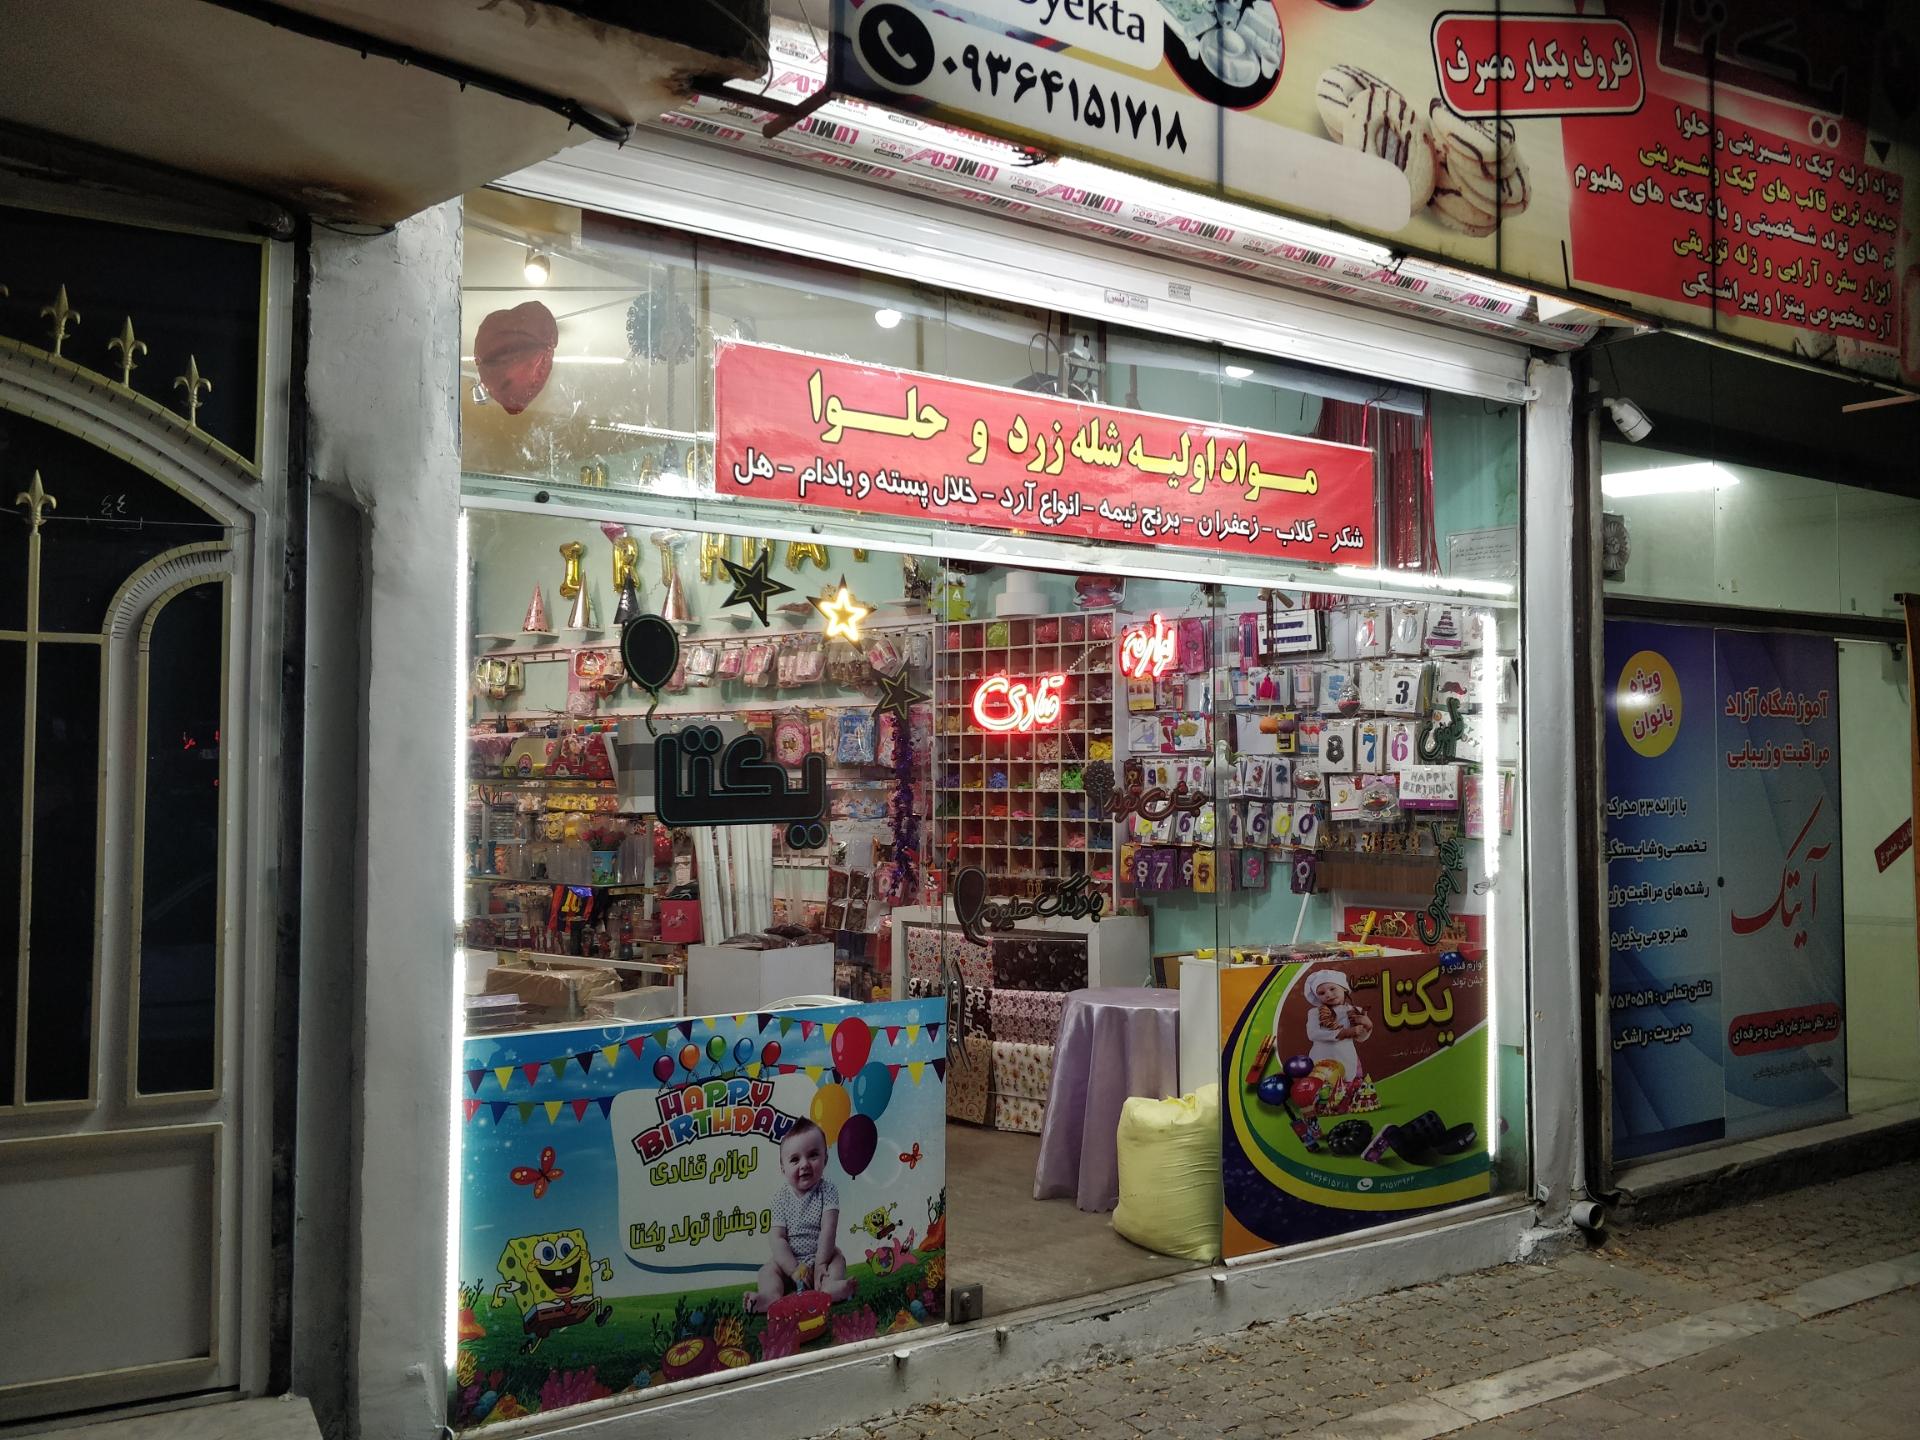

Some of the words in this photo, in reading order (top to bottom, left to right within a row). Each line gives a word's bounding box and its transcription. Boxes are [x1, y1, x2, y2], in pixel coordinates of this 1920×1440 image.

[1446, 37, 1516, 95] مصرف
[1523, 37, 1573, 92] یکبار
[1574, 38, 1633, 89] ظروف
[942, 44, 1187, 154] ۰۹۳۶۴۱۵۱۷۱۸
[797, 115, 860, 145] LUMIC
[1675, 107, 1710, 139] حلوا
[1715, 130, 1724, 150] و
[1728, 131, 1792, 166] شیرینی
[930, 150, 1000, 182] LUMICO
[1639, 142, 1712, 176] شیرینی
[1804, 153, 1835, 181] کیک
[1574, 162, 1624, 193] هلیوم
[1629, 176, 1664, 205] های
[1724, 166, 1757, 194] کیک
[1761, 179, 1791, 204] های
[1839, 165, 1869, 196] اولیه
[1872, 179, 1900, 204] مواد
[1062, 183, 1123, 213] LUMICO
[1794, 187, 1827, 212] قالب
[1733, 212, 1741, 232] و
[1830, 200, 1861, 227] ترین
[1863, 210, 1897, 240] جدید
[1180, 217, 1235, 242] LUMICO
[1746, 213, 1818, 247] شخصیتی
[1285, 244, 1334, 269] LUMICO
[1673, 228, 1728, 265] تزریقی
[1734, 242, 1759, 275] ژله
[1822, 231, 1849, 259] تولد
[1853, 240, 1879, 264] های
[1380, 271, 1429, 293] LUMICO
[1763, 262, 1772, 278] و
[1778, 257, 1820, 288] آرایی
[1825, 269, 1857, 295] سفره
[1470, 294, 1513, 315] LUMICO
[1682, 272, 1760, 314] پیراشکی
[1763, 295, 1772, 316] و
[1862, 278, 1892, 305] ابزار
[1776, 290, 1805, 323] پیتزا
[1809, 305, 1864, 330] مخصوص
[1869, 314, 1892, 340] آرد
[808, 369, 949, 444] حلوا
[967, 418, 989, 464] و
[1007, 414, 1065, 476] زرد
[1070, 417, 1122, 468] شله
[733, 446, 775, 485] هل
[799, 456, 854, 497] بادام
[1127, 431, 1217, 494] اولیه
[1220, 440, 1318, 501] مواد
[856, 470, 871, 499] و
[874, 468, 929, 509] پسته
[932, 474, 978, 507] خلال
[1000, 480, 1037, 515] آرد
[1039, 488, 1080, 524] انواع
[1099, 498, 1138, 529] نیمه
[1141, 504, 1180, 536] برنج
[1197, 510, 1259, 542] زعفران
[1275, 519, 1316, 546] گلاب
[1331, 525, 1364, 552] شکر
[1120, 612, 1176, 678] لوازم
[1628, 667, 1662, 694] ویژه
[1725, 687, 1758, 723] آزاد
[1760, 688, 1829, 724] آموزشگاه
[1632, 705, 1674, 741] بانوان
[1326, 735, 1344, 763] 8
[1363, 733, 1377, 762] 7
[1391, 733, 1408, 761] 6
[1727, 740, 1772, 769] زیبایی
[1773, 748, 1782, 768] و
[1783, 740, 1830, 768] مراقبت
[654, 725, 828, 850] یکتا
[1410, 771, 1447, 782] HAPPY
[1639, 798, 1654, 816] ۲۳
[1655, 796, 1677, 817] ارائه
[1679, 796, 1688, 816] با
[1658, 844, 1664, 859] و
[1664, 839, 1707, 860] تخصصی
[1619, 890, 1626, 906] و
[1627, 882, 1662, 904] مراقبت
[1664, 881, 1682, 902] های
[1685, 881, 1710, 898] رشته
[1610, 926, 1643, 951] پذیرد
[1643, 931, 1657, 947] می
[1657, 926, 1688, 944] هنرجو
[1688, 980, 1712, 1001] تلفن
[1381, 965, 1455, 1047] یکتا
[1613, 1027, 1648, 1051] راشکی
[1743, 1024, 1763, 1041] حرفه
[1763, 1027, 1770, 1040] و
[1769, 1020, 1784, 1039] فنی
[1784, 1017, 1813, 1036] سازمان
[658, 1077, 774, 1122] HAPPY
[633, 1105, 797, 1164] BIRTHDAY
[649, 1153, 707, 1186] قنادی
[709, 1147, 758, 1184] لوازم
[668, 1212, 710, 1246] تولد
[712, 1205, 757, 1241] جشن
[760, 1208, 771, 1233] و
[629, 1221, 666, 1252] یکتا
